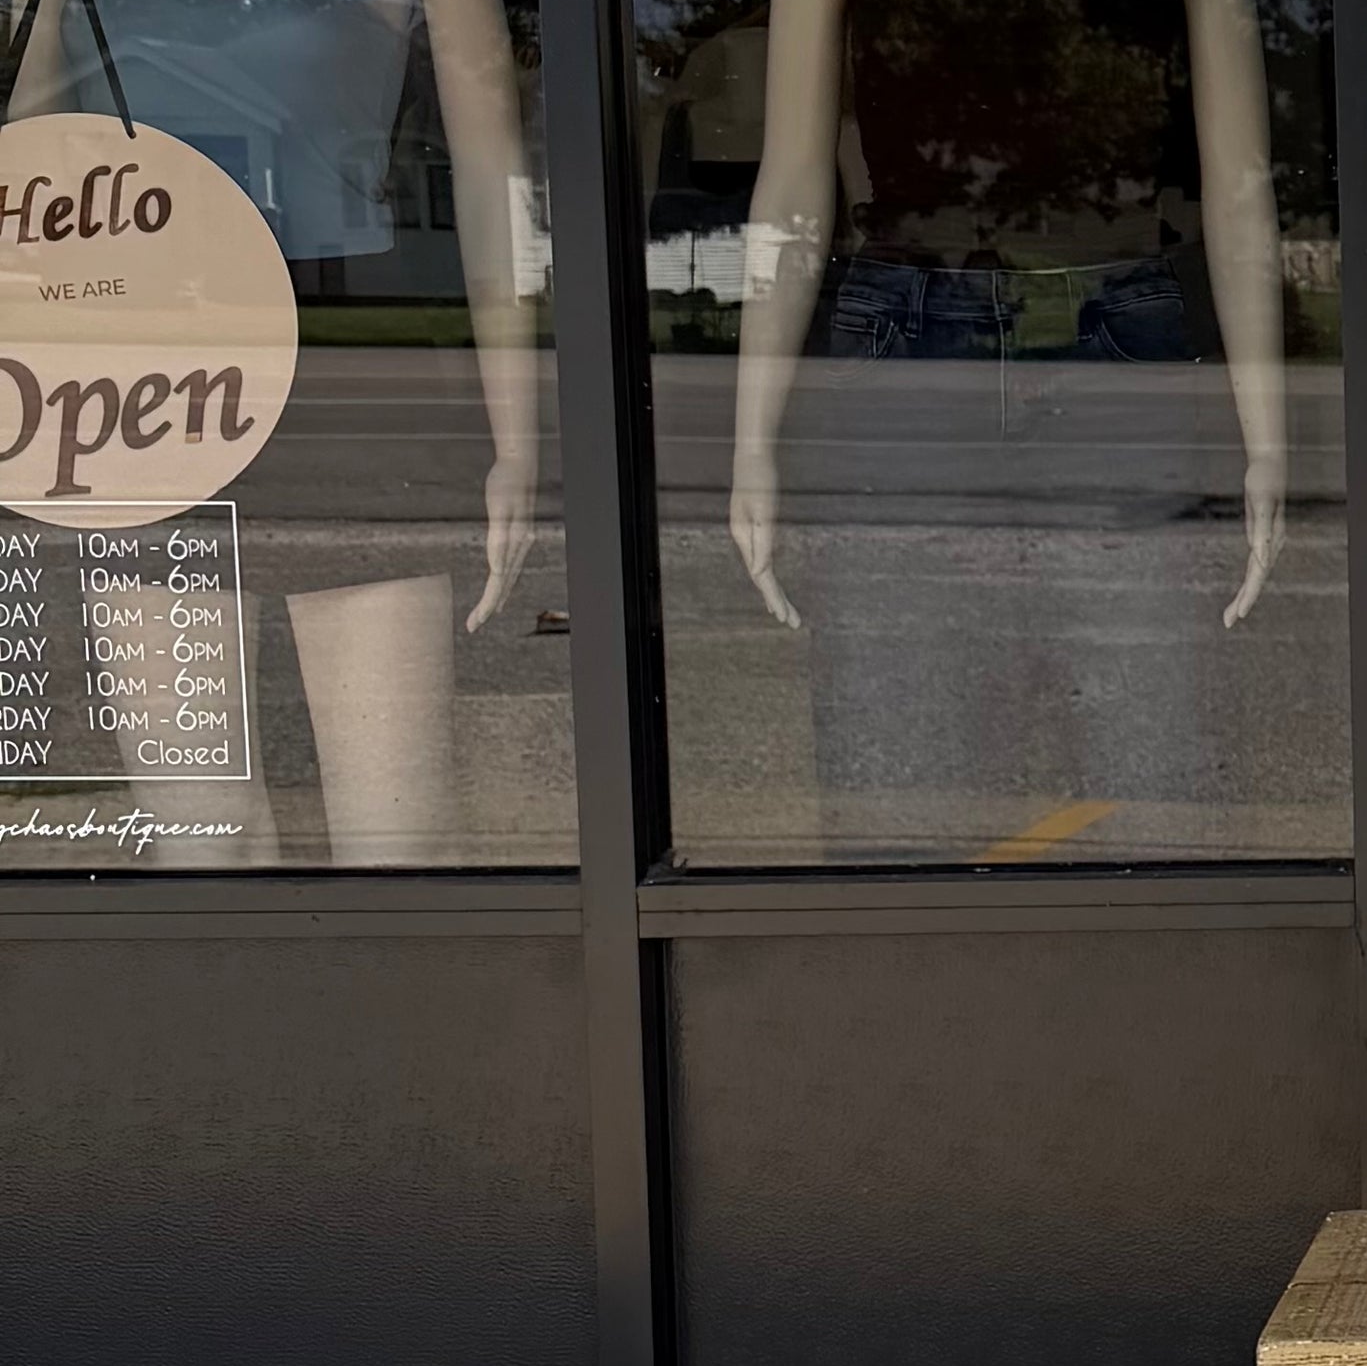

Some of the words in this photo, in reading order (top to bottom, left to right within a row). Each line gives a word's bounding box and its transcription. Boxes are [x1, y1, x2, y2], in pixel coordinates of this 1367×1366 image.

[38, 283, 77, 302] WE
[82, 278, 127, 299] ARE
[78, 532, 139, 558] 10AM
[167, 529, 218, 560] 6PM
[80, 567, 141, 593] 10AM
[168, 565, 220, 593] 6PM
[83, 602, 143, 627] 10AM
[170, 599, 222, 628] 6PM
[85, 636, 145, 661] 10AM
[173, 634, 224, 662] 6PM
[86, 671, 147, 696] 10AM
[175, 668, 226, 697] 6PM
[89, 706, 149, 730] 10AM
[176, 702, 228, 731] 6PM
[138, 739, 230, 765] Closed
